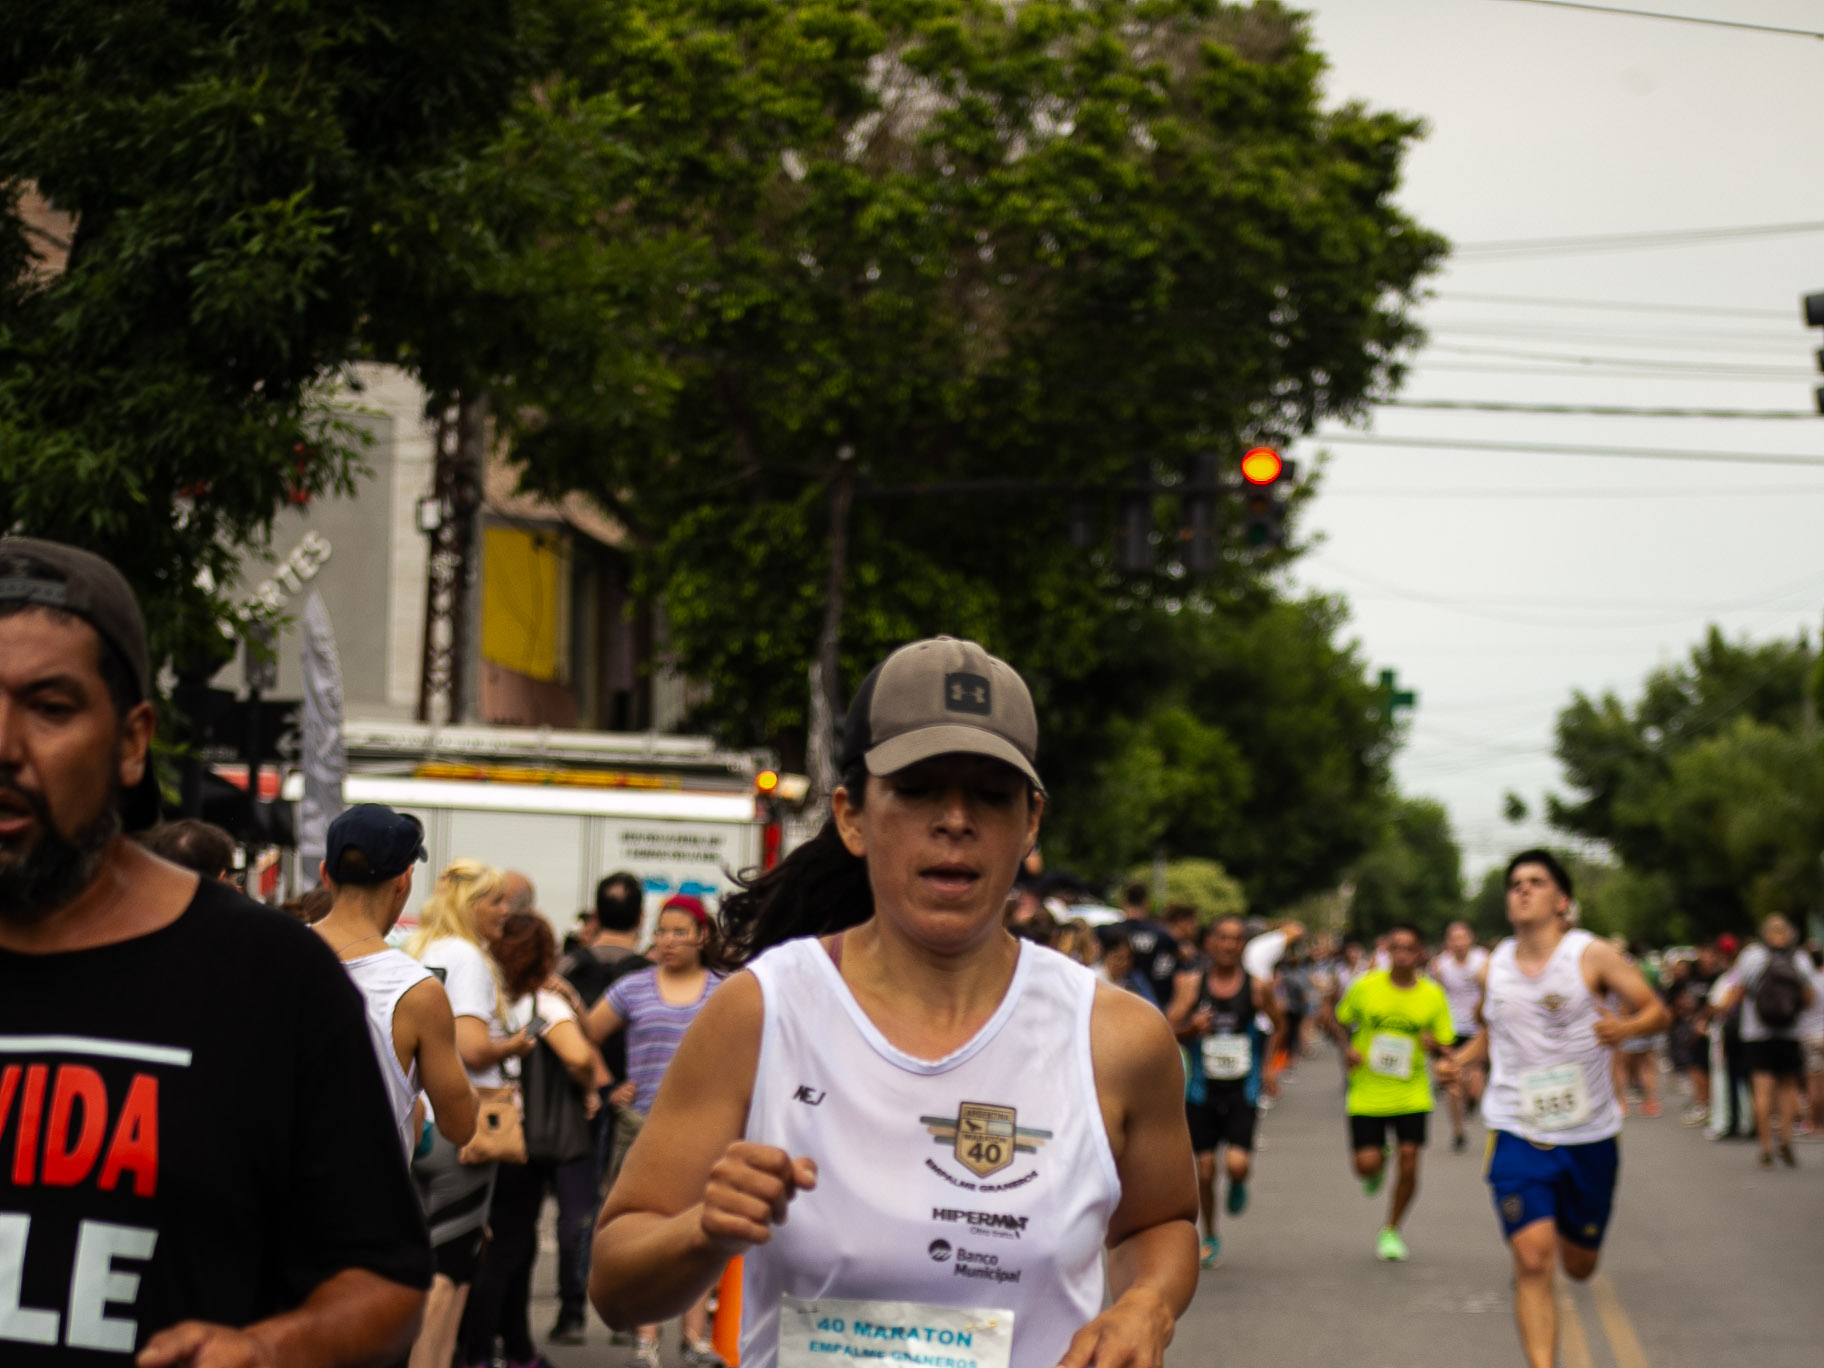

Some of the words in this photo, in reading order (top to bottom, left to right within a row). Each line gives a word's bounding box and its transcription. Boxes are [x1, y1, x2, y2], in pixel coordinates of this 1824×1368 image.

[967, 1143, 1003, 1164] 40
[925, 1158, 976, 1191] EMPALME
[957, 1248, 999, 1266] Banco
[954, 1263, 1022, 1284] Municipal
[816, 1317, 846, 1334] 40
[853, 1321, 974, 1348] MARATON
[808, 1340, 885, 1360] EMPALME
